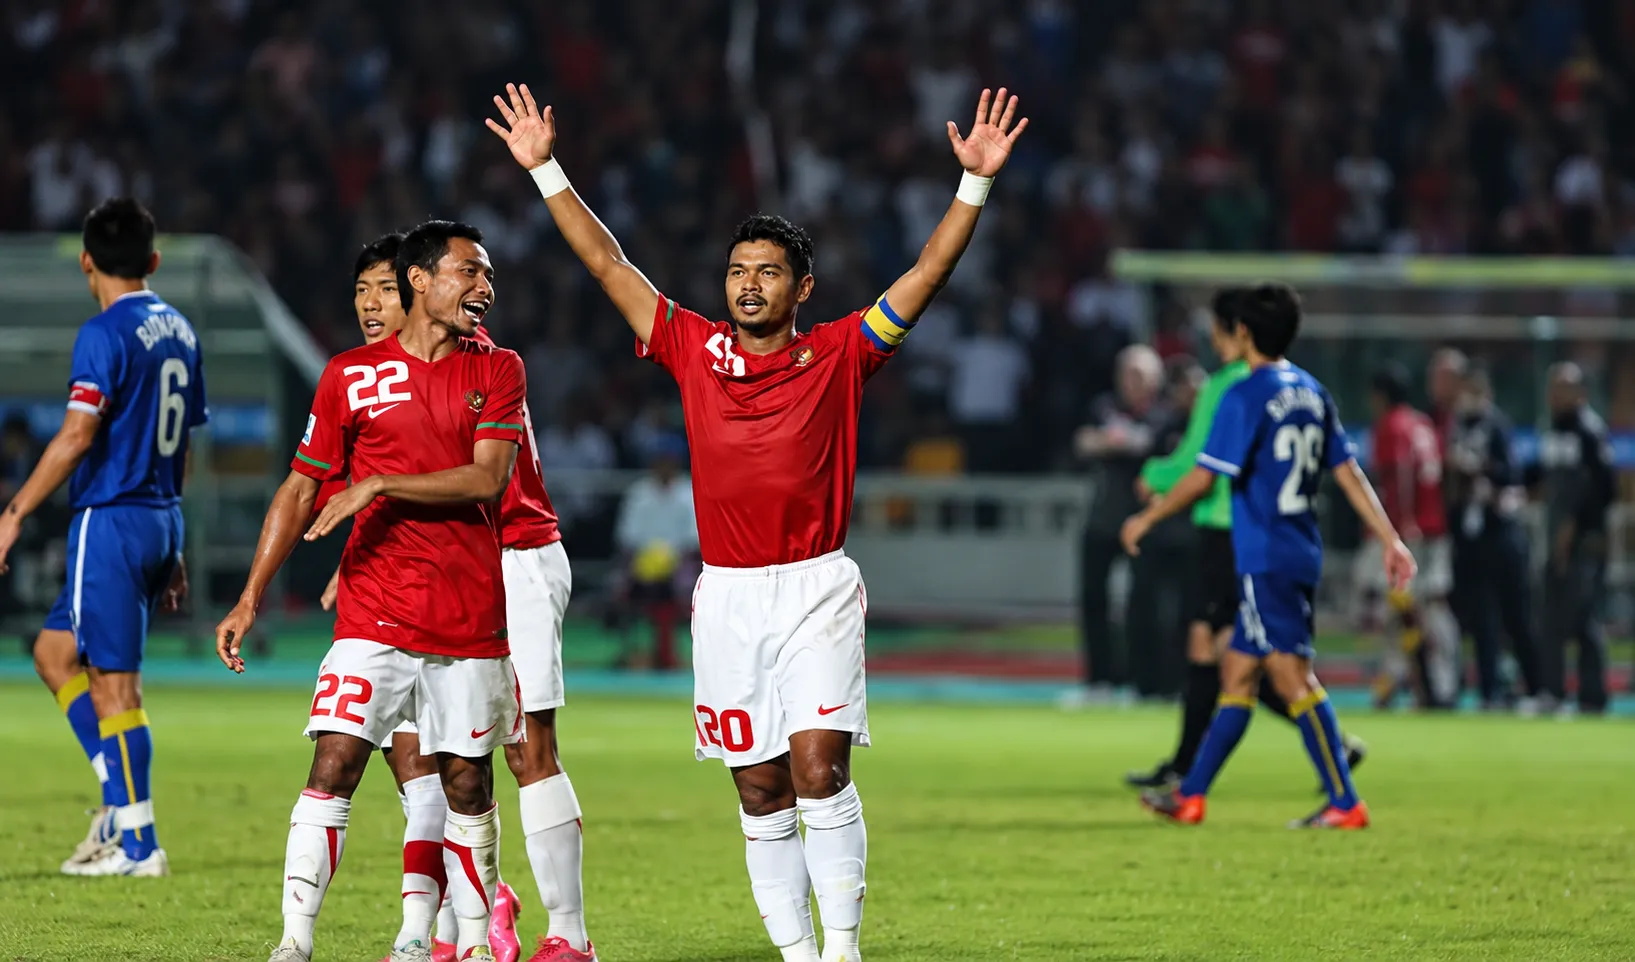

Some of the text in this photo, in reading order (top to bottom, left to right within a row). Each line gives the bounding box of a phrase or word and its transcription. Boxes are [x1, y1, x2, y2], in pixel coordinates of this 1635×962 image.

[157, 357, 189, 457] 6
[343, 360, 412, 412] 22
[310, 672, 373, 727] 22
[696, 705, 754, 752] 20
